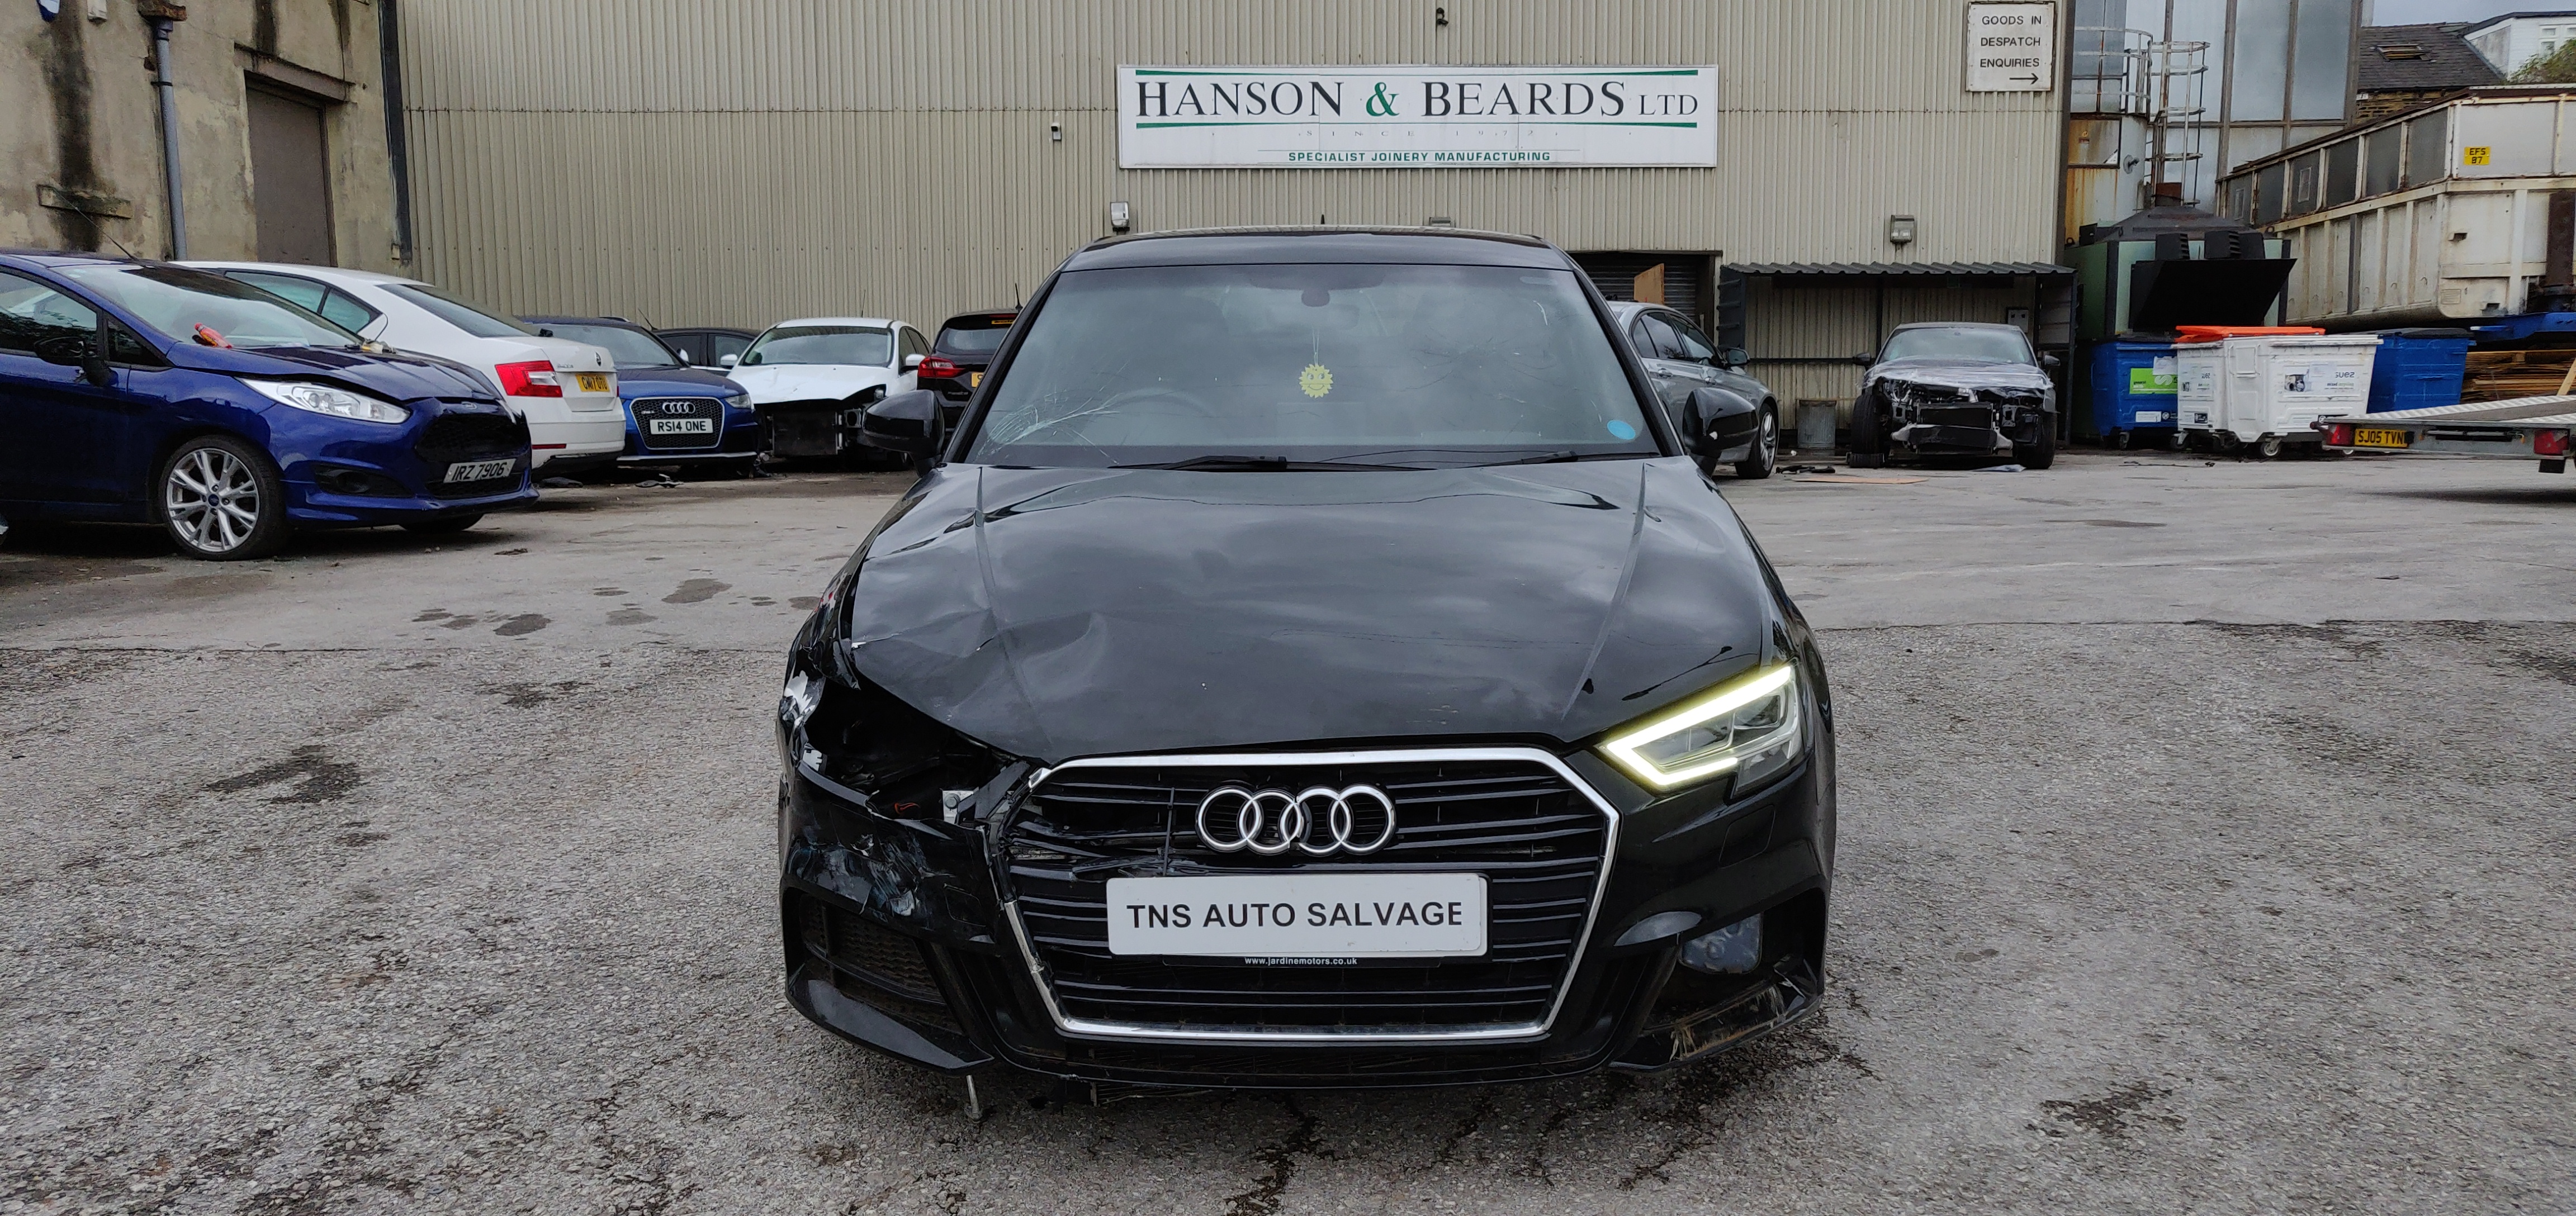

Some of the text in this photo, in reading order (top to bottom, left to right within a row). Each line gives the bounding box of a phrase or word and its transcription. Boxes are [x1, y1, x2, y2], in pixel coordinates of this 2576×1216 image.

[1982, 15, 2042, 25] GOODS IN
[1981, 37, 2040, 46] DESPATCH
[1980, 58, 2040, 68] ENQUIRIES
[1135, 81, 1698, 117] HANSON & BEARDS LTD
[1289, 151, 1550, 162] SPECIALIST JOINERY MANUFACTURING
[657, 421, 707, 432] RS14 ONE
[2358, 430, 2404, 444] SJ05 TVN
[452, 462, 507, 481] IRZ 7906
[1126, 901, 1462, 928] TNS AUTO SALVAGE
[1244, 957, 1358, 966] www.jardinemotors.co.uk
